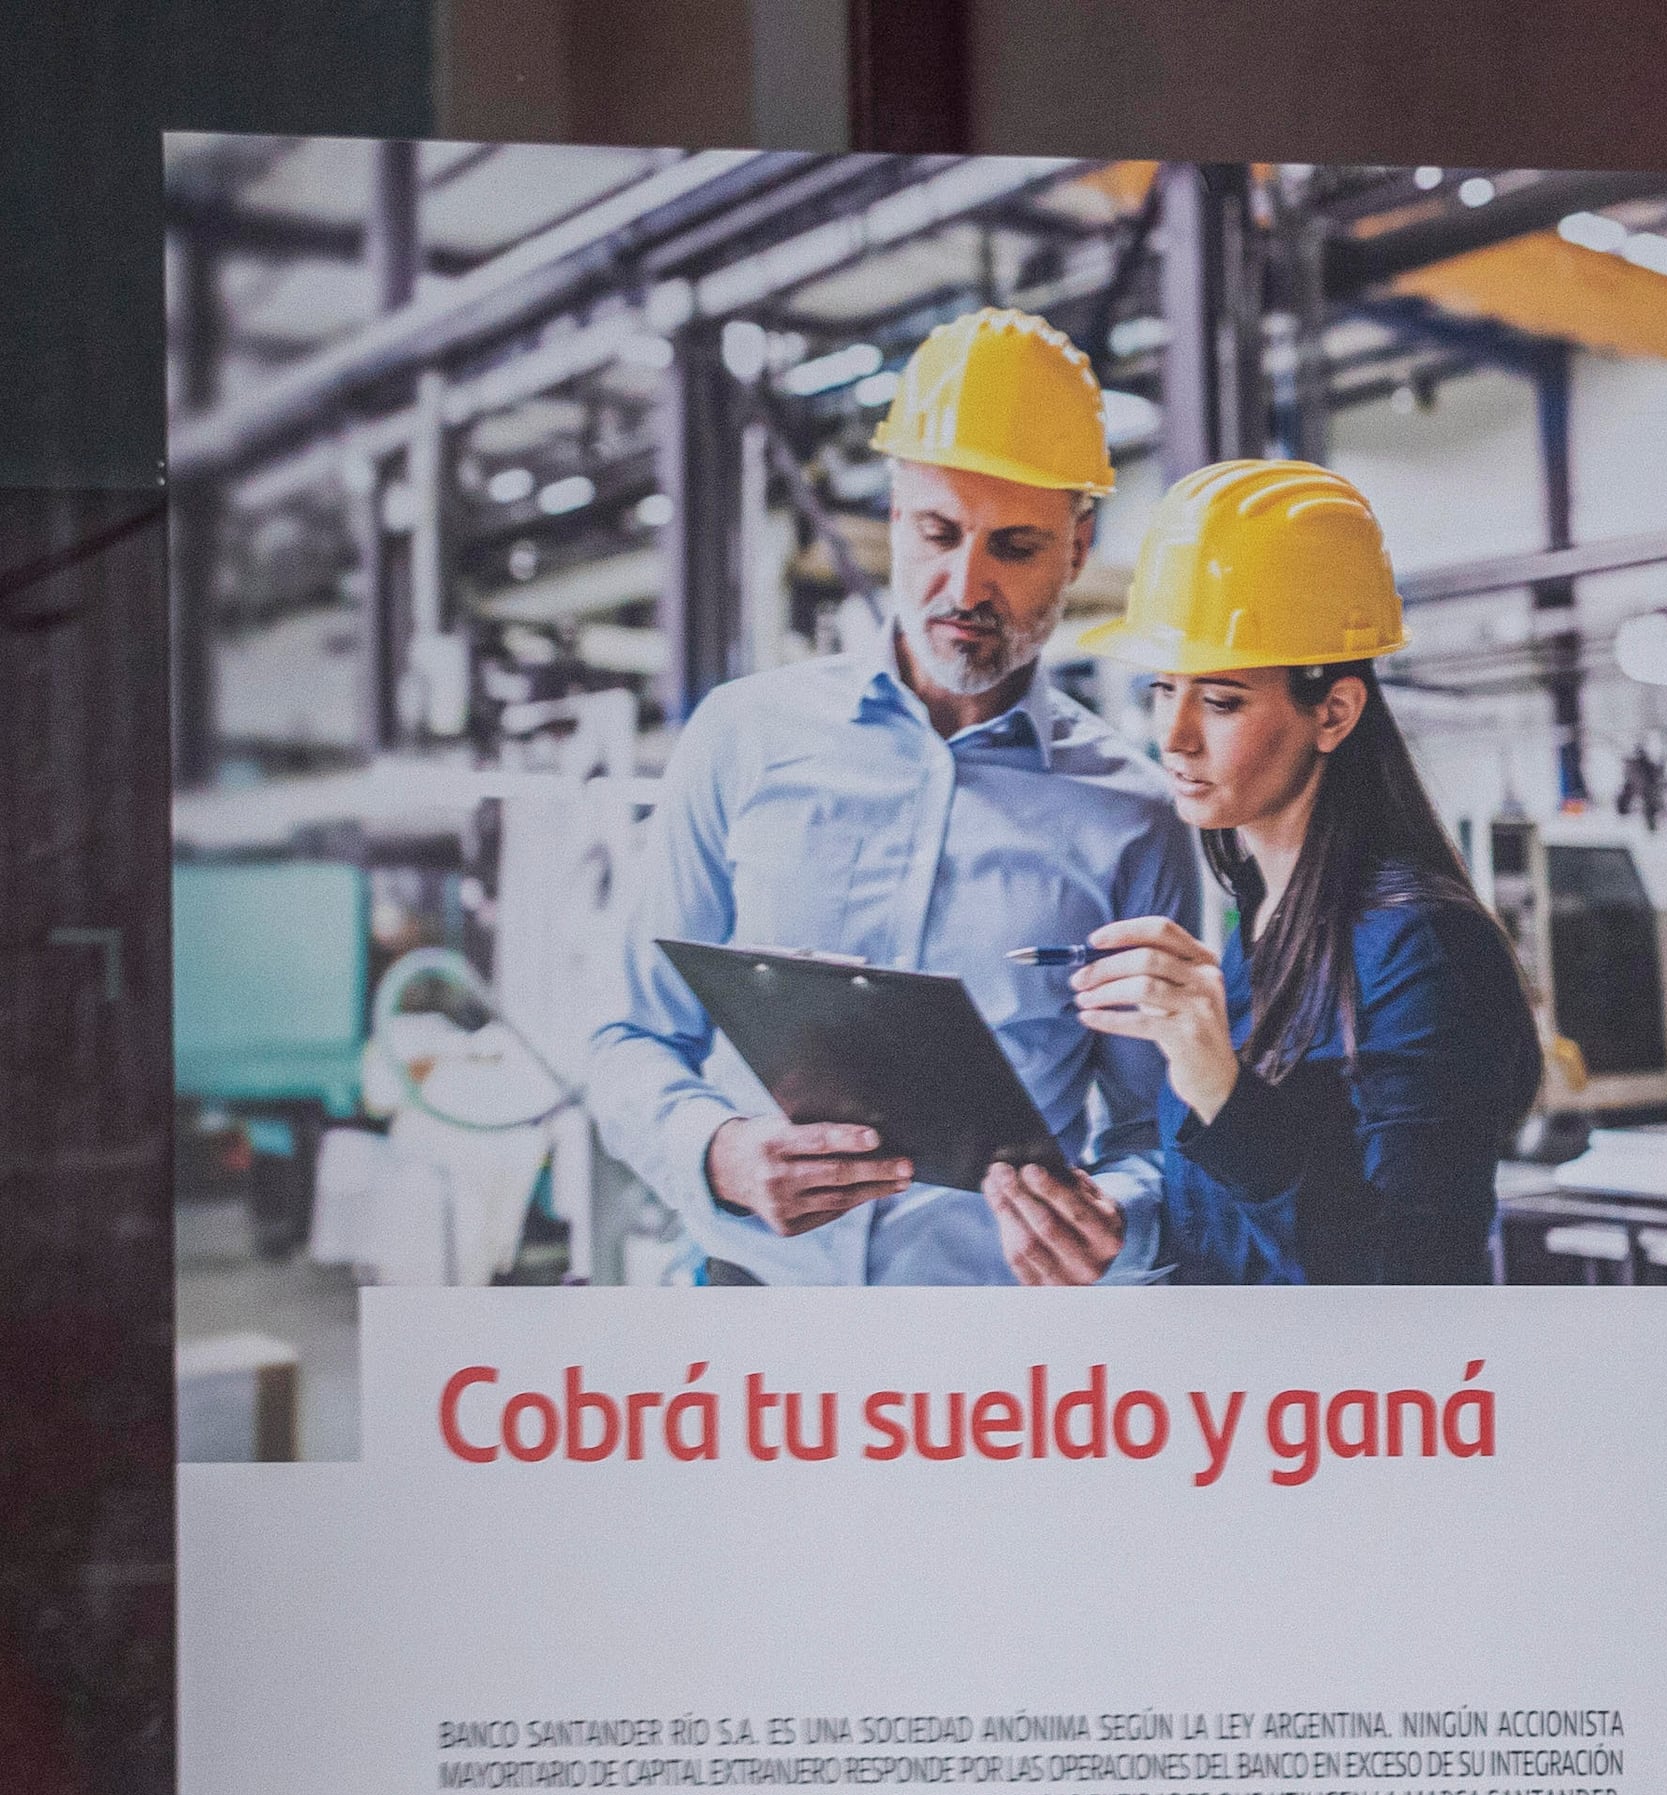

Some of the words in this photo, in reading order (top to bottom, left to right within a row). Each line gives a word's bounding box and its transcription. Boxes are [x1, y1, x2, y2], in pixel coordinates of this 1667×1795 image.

[440, 1362, 718, 1463] Cobrá
[747, 1373, 838, 1462] tu
[864, 1364, 1171, 1462] sueldo
[1190, 1391, 1246, 1487] y
[1267, 1360, 1497, 1486] ganá
[438, 1720, 520, 1748] BANCO
[526, 1718, 663, 1748] SANTANDER
[671, 1712, 710, 1747] RÍO
[717, 1717, 759, 1746] S.A.
[767, 1717, 796, 1746] ES
[803, 1717, 852, 1744] UNA
[860, 1715, 974, 1744] SOCIEDAD
[982, 1709, 1089, 1742] ANÓNIMA
[1099, 1707, 1173, 1741] SEGÚN
[1183, 1713, 1208, 1740] LA
[1217, 1712, 1255, 1740] LEY
[1263, 1711, 1392, 1740] ARGENTINA.
[1402, 1705, 1487, 1738] NINGÚN
[1498, 1709, 1624, 1738] ACCIONISTA
[590, 1759, 619, 1788] DE
[623, 1759, 706, 1787] CAPITAL
[711, 1757, 841, 1785] EXTRANJERO
[845, 1756, 954, 1784] RESPONDE
[958, 1756, 1004, 1783] POR
[1008, 1755, 1044, 1782] LAS
[1049, 1753, 1191, 1782] OPERACIONES
[1195, 1752, 1231, 1780] DEL
[1237, 1751, 1309, 1780] BANCO
[1313, 1751, 1340, 1779] EN
[1346, 1750, 1423, 1779] EXCESO
[1428, 1750, 1453, 1778] DE
[1458, 1750, 1485, 1777] SU
[1490, 1743, 1624, 1777] INTEGRACIÓN
